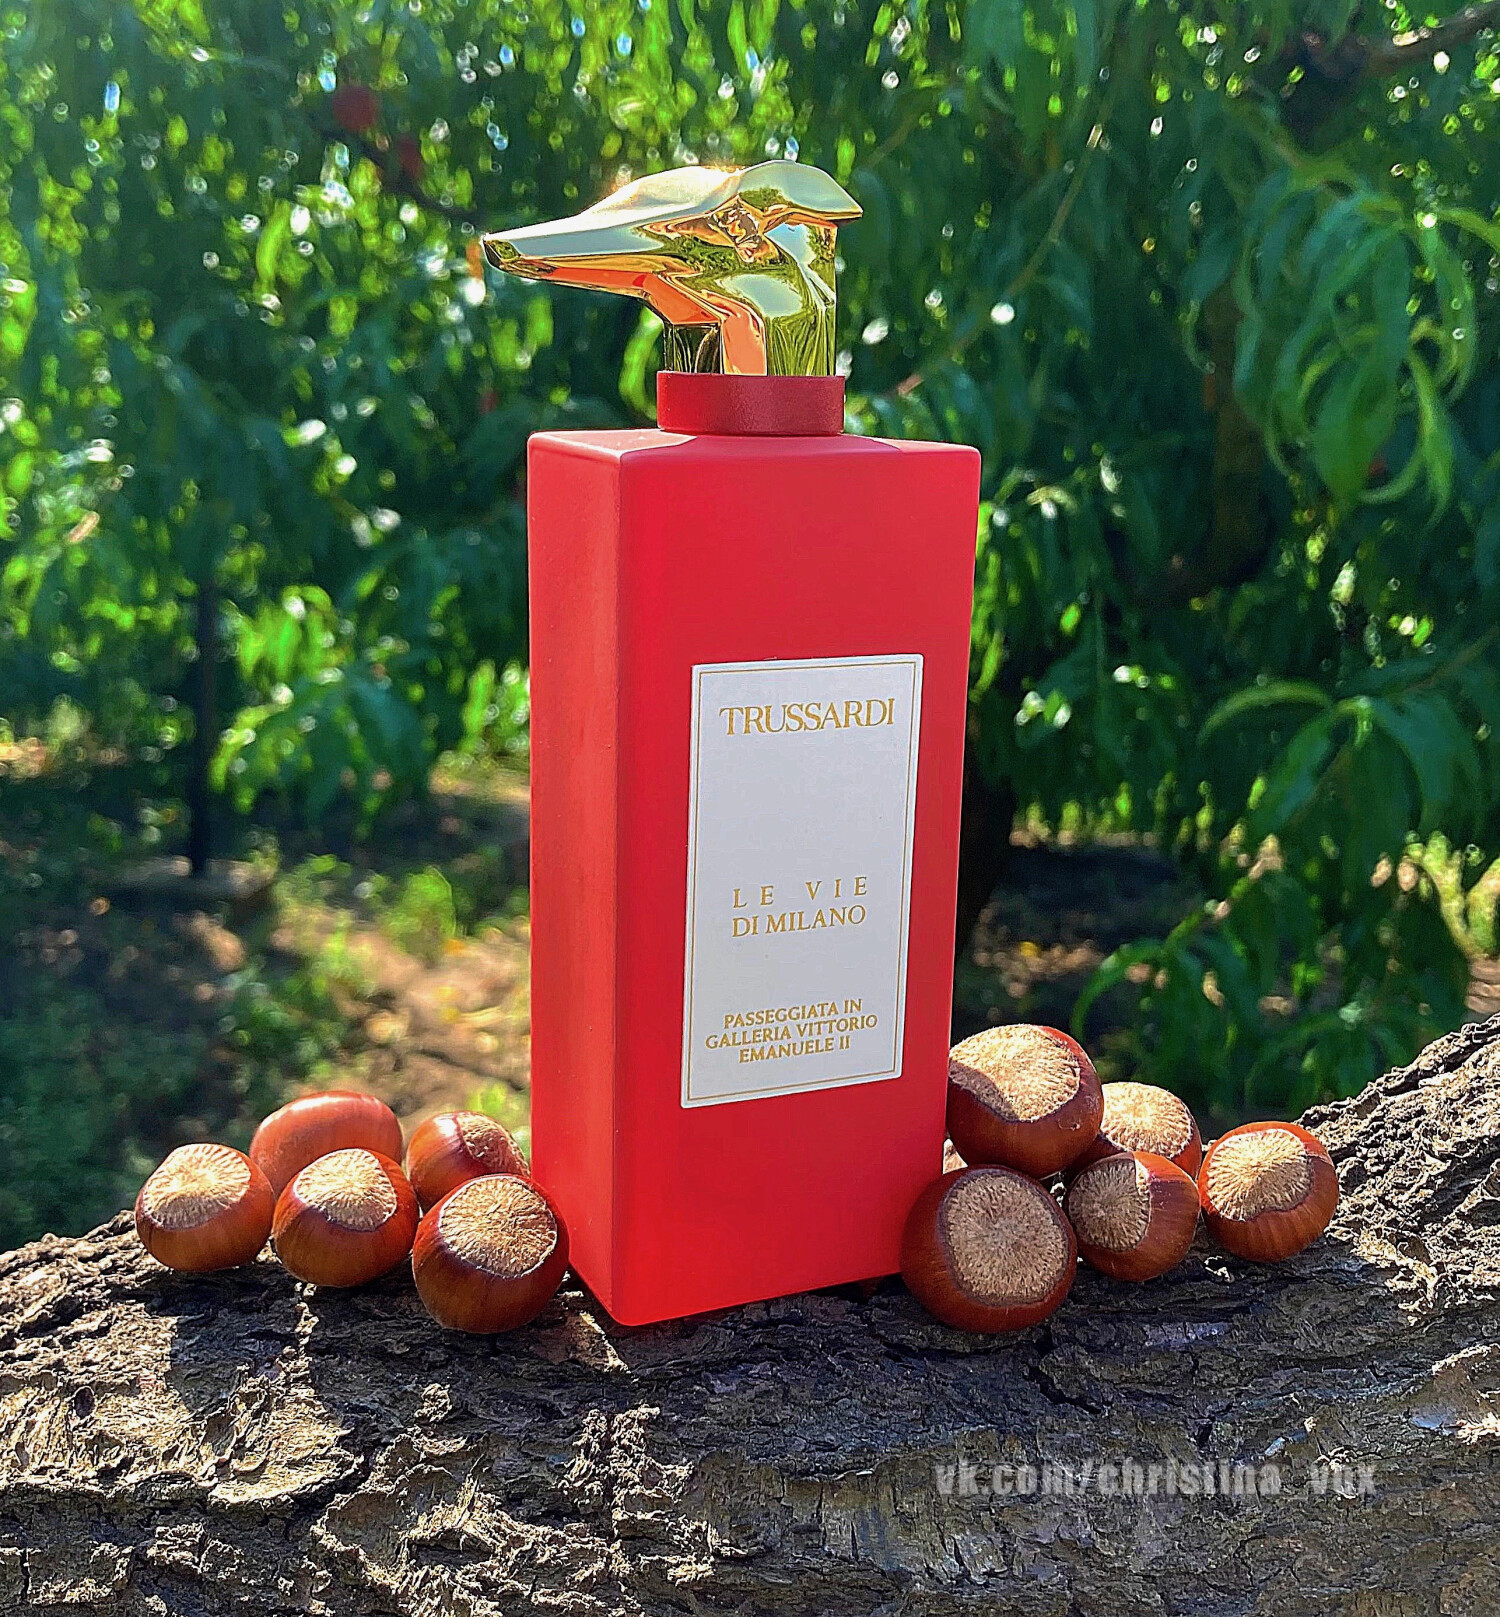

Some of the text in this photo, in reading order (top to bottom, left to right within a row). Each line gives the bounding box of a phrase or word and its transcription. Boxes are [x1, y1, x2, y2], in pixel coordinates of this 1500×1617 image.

[719, 698, 895, 735] TRUSSARDI
[733, 876, 868, 908] LE VIE
[732, 904, 866, 938] DI MILANO
[724, 998, 862, 1029] PASSEGGIATA IN
[705, 1014, 878, 1050] GALLERIA VITTORIO
[739, 1035, 850, 1063] EMANUELE II
